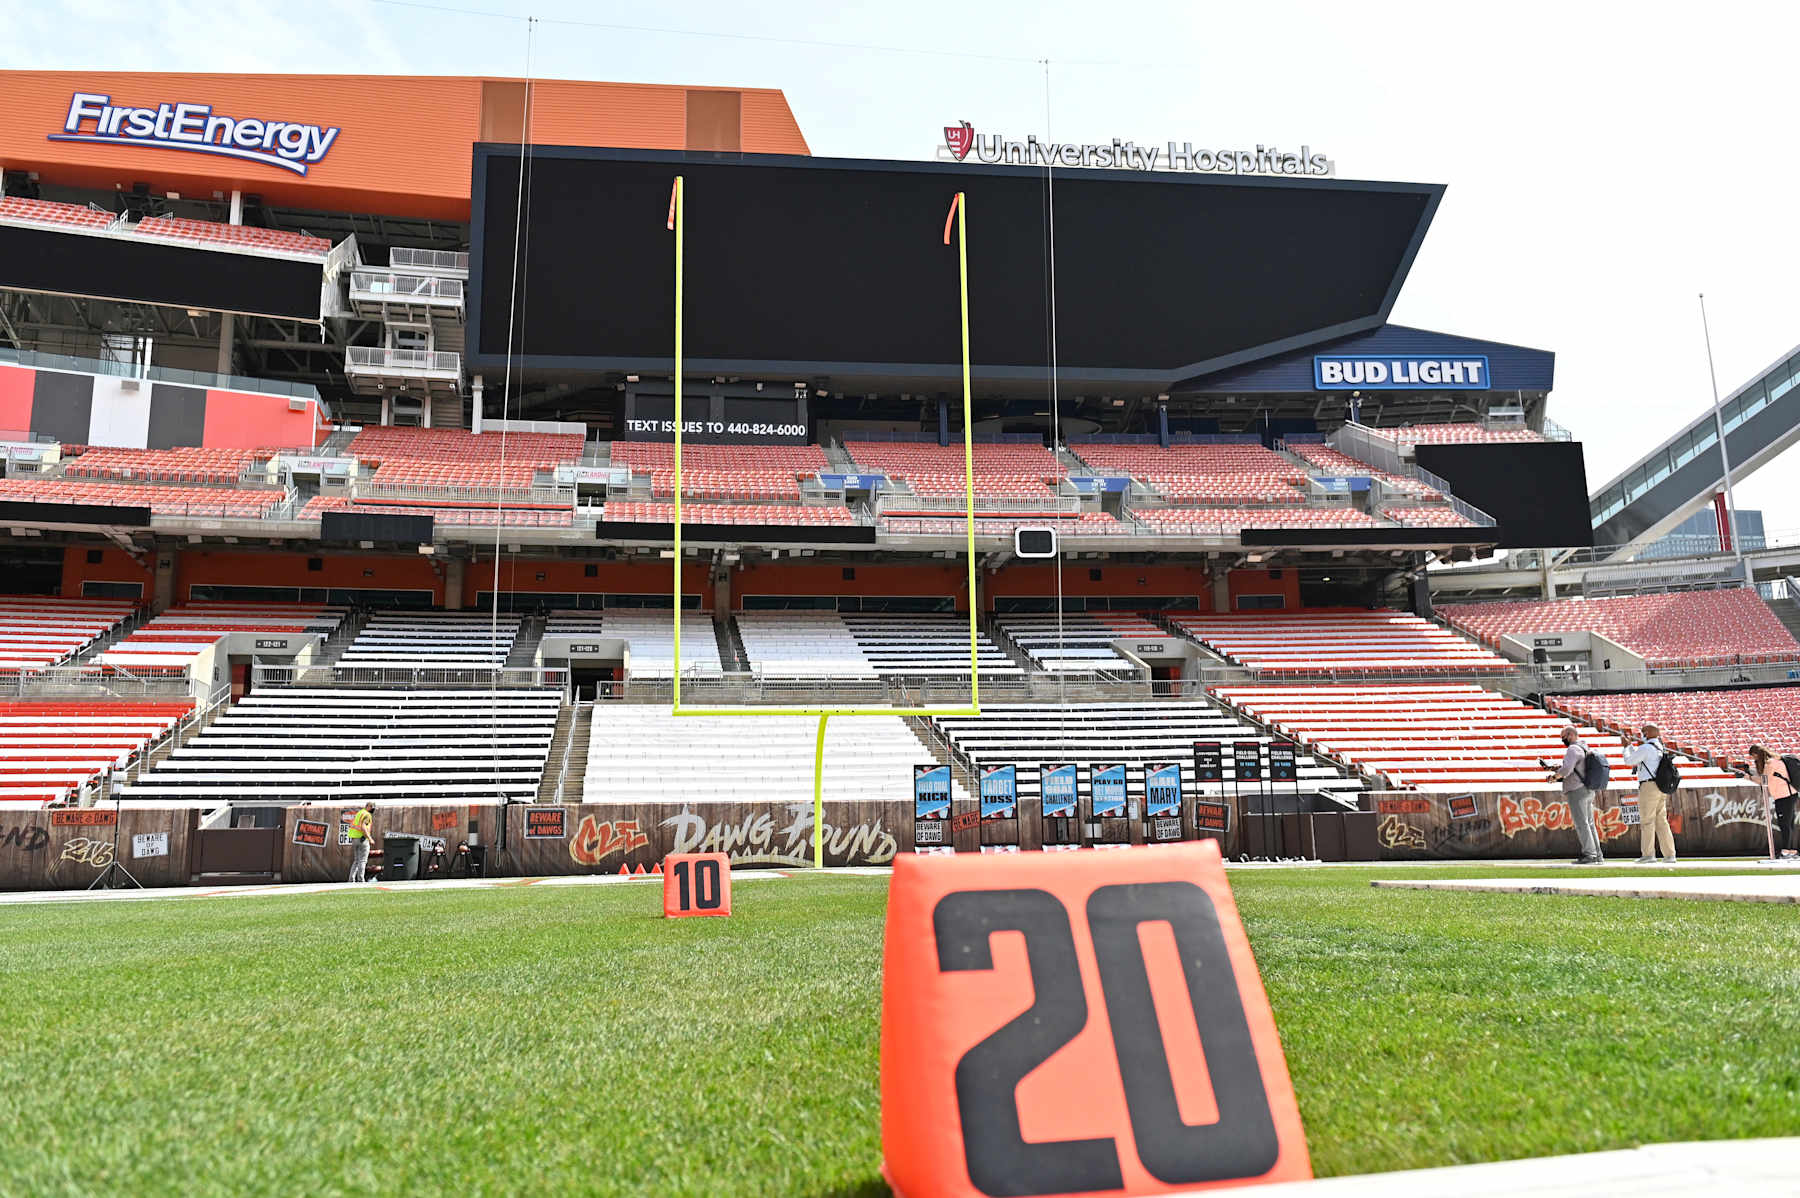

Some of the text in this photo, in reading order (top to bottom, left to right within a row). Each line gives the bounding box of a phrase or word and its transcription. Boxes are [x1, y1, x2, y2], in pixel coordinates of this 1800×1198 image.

[64, 92, 341, 163] FirstEnergy
[976, 133, 1331, 176] University Hospitals
[1320, 361, 1483, 384] BUD LIGHT
[627, 419, 806, 436] TEXT ISSUES TO 440-824-6000
[918, 792, 949, 802] KICK
[984, 795, 1013, 804] TOSS
[1150, 787, 1177, 805] MARY
[529, 812, 562, 824] BEWARE
[1156, 819, 1180, 829] BEWARE
[1497, 794, 1629, 843] BROS
[537, 825, 562, 835] DAWGS
[657, 803, 778, 856] DAWG
[916, 823, 941, 831] BEWARE
[1165, 828, 1181, 838] DAWG
[0, 825, 50, 851] ND
[137, 833, 164, 843] BEWARE
[568, 813, 650, 866] CLE
[916, 831, 941, 841] OF DAWG
[141, 847, 161, 856] DAWG
[673, 859, 721, 911] 10
[932, 880, 1280, 1198] 20
